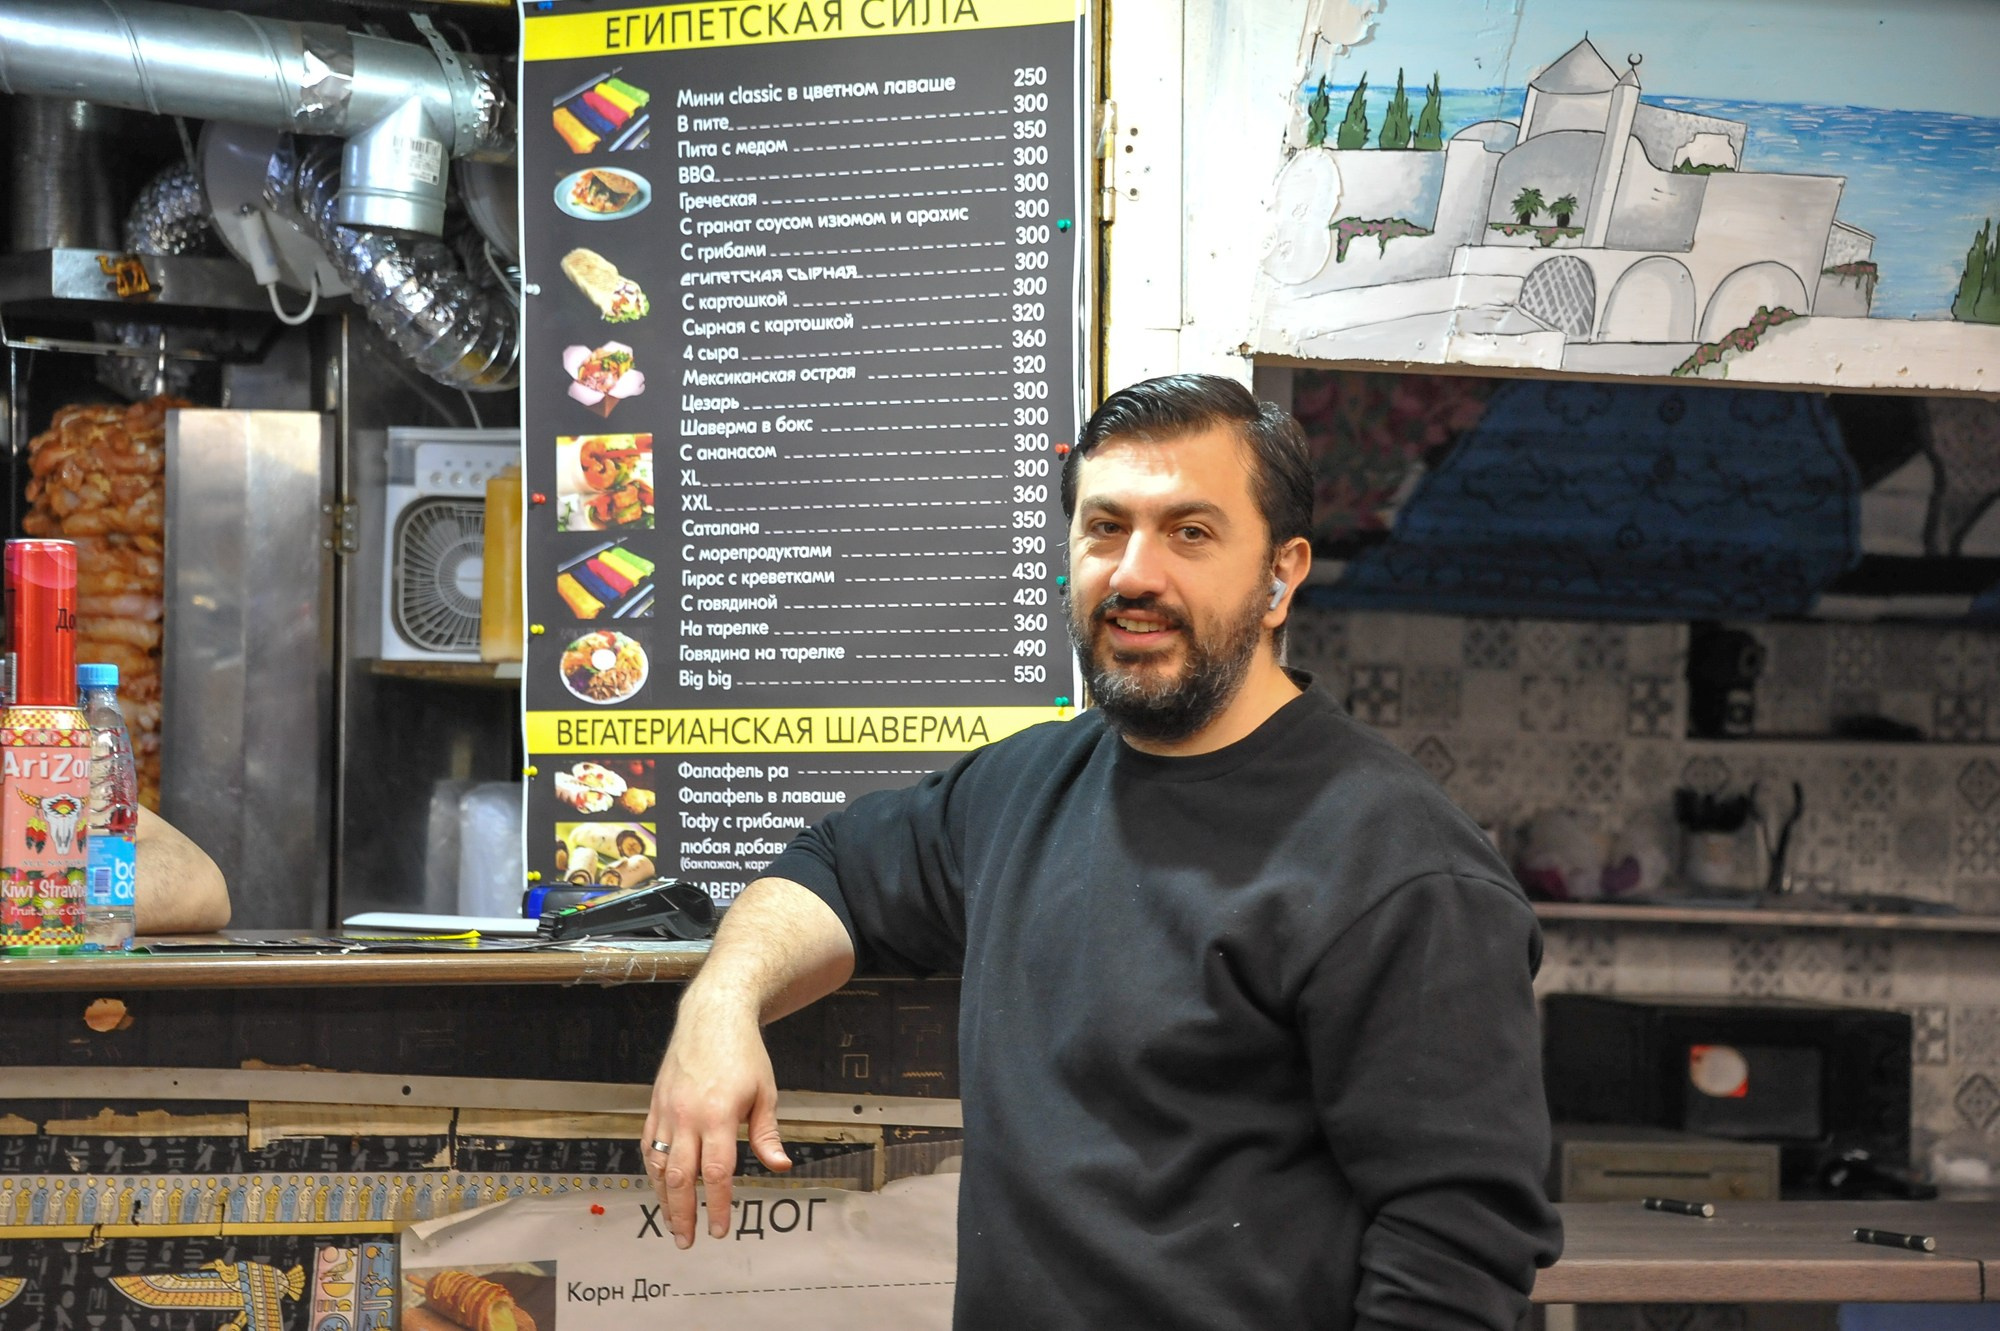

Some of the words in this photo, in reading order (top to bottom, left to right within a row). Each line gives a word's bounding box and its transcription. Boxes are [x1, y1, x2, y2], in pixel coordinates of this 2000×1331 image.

[606, 0, 842, 49] ЕГИПЕТСКАЯ
[862, 0, 978, 28] СИЛА
[677, 89, 724, 108] Мини
[729, 84, 782, 104] classic
[788, 87, 798, 100] в
[803, 82, 879, 102] цветном
[883, 77, 956, 95] лаваше
[1014, 66, 1047, 87] 250
[678, 115, 688, 132] В
[693, 117, 729, 131] пите
[1013, 93, 1048, 113] 300
[678, 141, 717, 158] Пита
[722, 143, 731, 155] с
[735, 140, 788, 156] медом
[1013, 119, 1046, 139] 350
[679, 166, 715, 184] BBQ
[1013, 146, 1046, 166] 300
[680, 192, 757, 213] Греческая
[1014, 172, 1048, 192] 300
[680, 217, 692, 235] С
[697, 219, 752, 238] гранат
[756, 216, 813, 234] соусом
[818, 212, 886, 228] изюмом
[891, 211, 901, 224] и
[906, 207, 969, 227] арахис
[1015, 198, 1049, 218] 300
[681, 243, 693, 260] С
[698, 241, 766, 263] грибами
[1016, 225, 1050, 245] 300
[1015, 251, 1049, 270] 300
[682, 293, 694, 310] С
[699, 290, 787, 313] картошкой
[1013, 276, 1047, 296] 300
[683, 318, 745, 339] Сырная
[750, 320, 760, 333] с
[765, 313, 854, 336] картошкой
[1012, 303, 1045, 322] 320
[683, 345, 693, 361] 4
[698, 347, 739, 364] сыра
[1012, 329, 1046, 348] 360
[682, 369, 796, 386] Мексиканская
[800, 366, 856, 383] острая
[1013, 355, 1046, 374] 320
[682, 394, 739, 413] Цезарь
[1013, 381, 1048, 400] 300
[681, 419, 757, 438] Шаверма
[762, 421, 771, 433] в
[776, 415, 813, 432] бокс
[1014, 407, 1049, 426] 300
[680, 444, 692, 461] С
[697, 446, 777, 460] ананасом
[1014, 433, 1049, 452] 300
[681, 469, 701, 486] XL
[1014, 459, 1049, 477] 300
[682, 494, 712, 511] XXL
[1013, 485, 1047, 503] 360
[682, 519, 759, 536] Саталана
[1012, 510, 1046, 528] 350
[682, 544, 694, 561] С
[699, 546, 831, 564] морепродуктами
[1012, 536, 1045, 554] 390
[682, 570, 724, 590] Гирос
[728, 573, 737, 585] с
[742, 571, 834, 588] креветками
[1012, 562, 1047, 580] 430
[681, 594, 693, 611] С
[698, 594, 777, 612] говядиной
[1013, 588, 1047, 605] 420
[681, 620, 702, 636] На
[706, 623, 769, 639] тарелке
[1013, 614, 1047, 631] 360
[680, 645, 750, 663] Говядина
[755, 648, 776, 660] на
[780, 647, 845, 663] тарелке
[1013, 639, 1046, 657] 490
[679, 670, 703, 690] Big
[708, 670, 731, 690] big
[1013, 665, 1046, 683] 550
[557, 717, 812, 746] ВЕГАТЕРИАНСКАЯ
[826, 716, 990, 744] ШАВЕРМА
[678, 762, 763, 782] Фалафель
[768, 766, 788, 782] ра
[679, 787, 763, 807] Фалафель
[768, 792, 777, 803] в
[782, 791, 846, 803] лаваше
[679, 812, 719, 832] Тофу
[723, 817, 732, 828] с
[736, 812, 804, 832] грибами
[680, 838, 730, 854] любая
[735, 838, 787, 856] добав
[1, 879, 34, 898] Kiwi
[688, 881, 751, 903] АВЕР
[637, 1198, 827, 1240] ХДОГ
[568, 1281, 624, 1305] Корн
[632, 1278, 671, 1302] Дог
